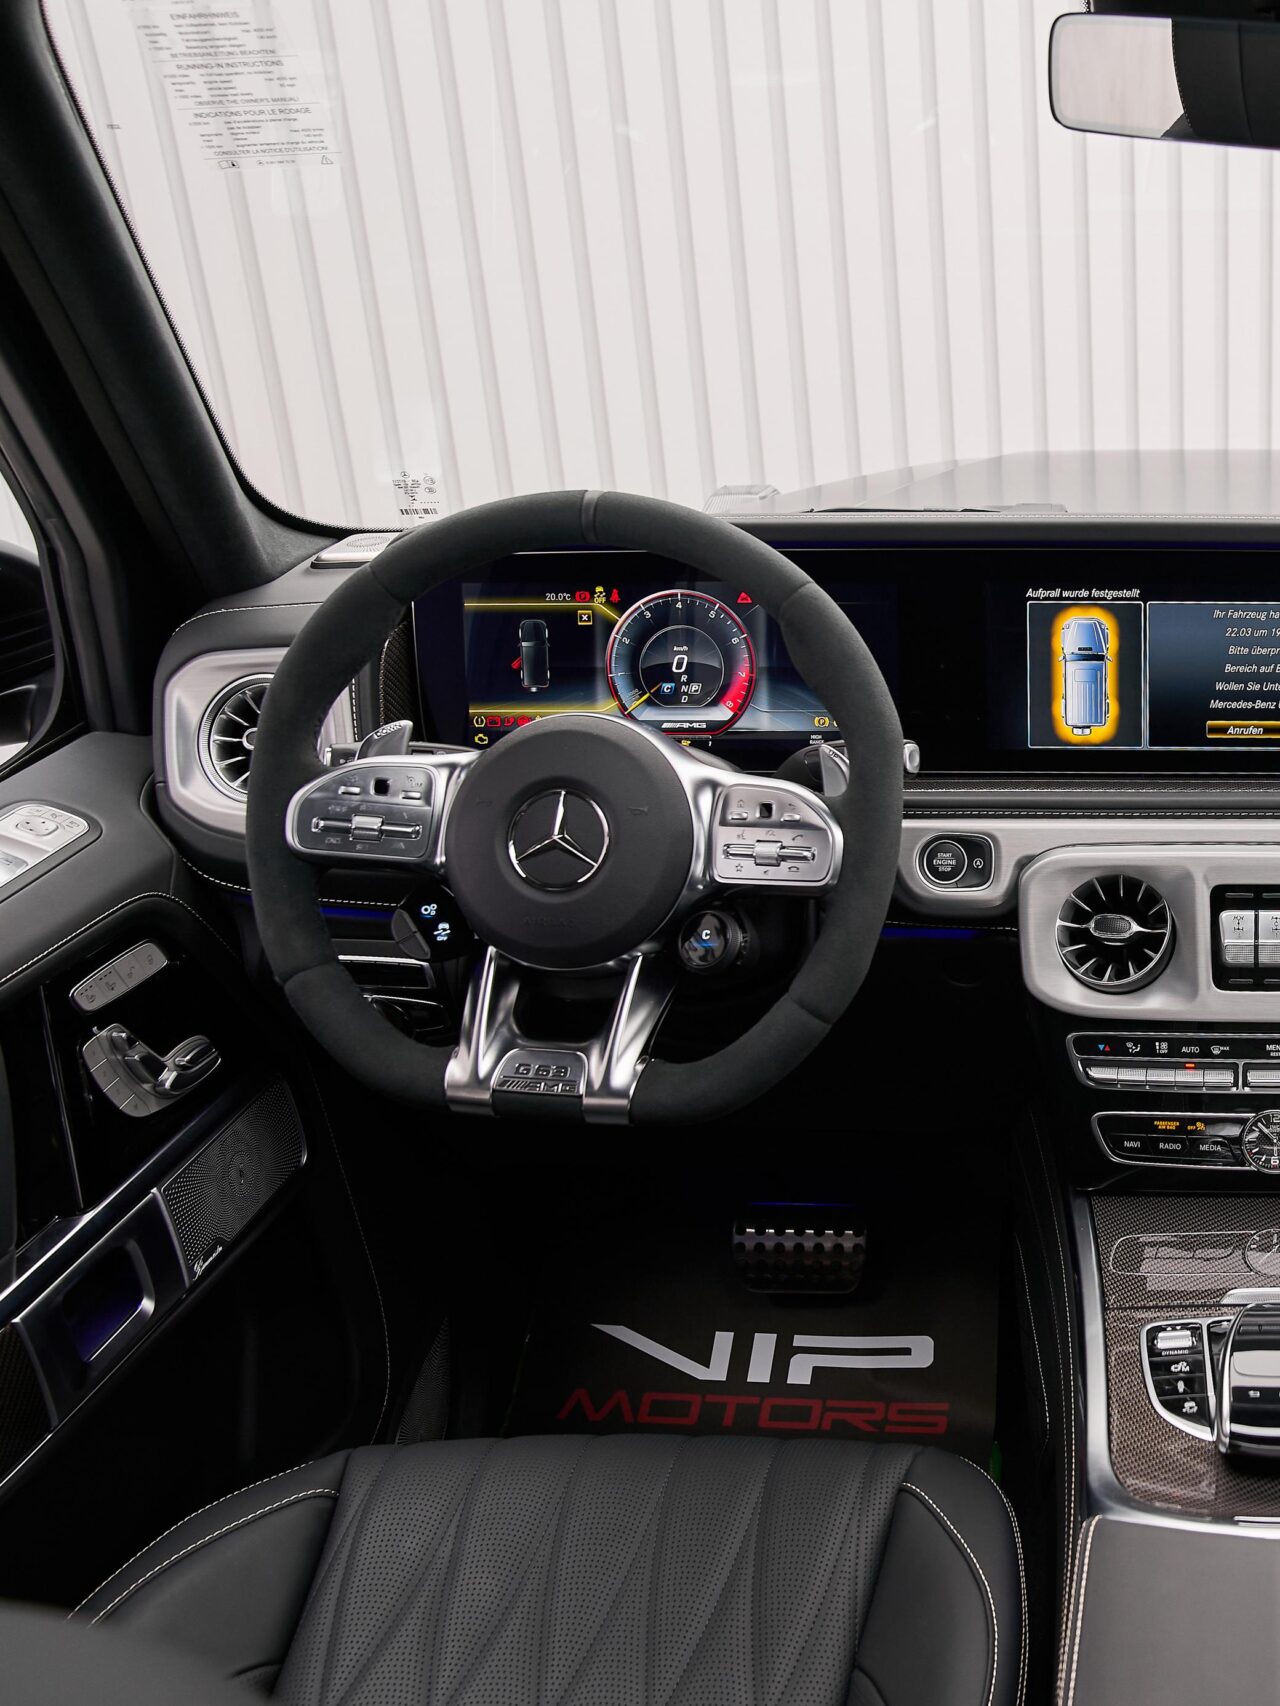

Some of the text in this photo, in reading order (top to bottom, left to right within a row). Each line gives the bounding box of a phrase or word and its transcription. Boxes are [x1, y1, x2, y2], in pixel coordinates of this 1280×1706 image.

[224, 60, 285, 69] INSTRUCTIONS
[193, 110, 243, 119] INDICATIONS
[244, 109, 266, 117] POUR
[279, 107, 312, 115] RODAGE
[1026, 588, 1140, 600] Aufprall wurde festgestellt
[643, 611, 652, 619] 3
[708, 611, 717, 619] 5
[1213, 609, 1226, 619] Ihr
[1227, 609, 1267, 620] Fahrzeug
[1225, 628, 1252, 637] 22.03
[1253, 629, 1268, 637] um
[622, 637, 630, 645] 2
[731, 637, 739, 645] 6
[1228, 645, 1249, 655] Bitte
[672, 655, 688, 673] 0
[1224, 663, 1258, 673] Bereich
[1259, 663, 1274, 673] auf
[1215, 681, 1245, 691] Wollen
[1246, 682, 1261, 691] Sie
[1209, 699, 1277, 709] Mercedes-Benz
[1226, 726, 1264, 735] Anrufen
[701, 930, 711, 940] C
[1181, 1046, 1200, 1054] AUTO
[1270, 1114, 1280, 1123] 12
[1124, 1140, 1141, 1148] NAVI
[1159, 1142, 1181, 1150] RADIO
[1271, 1156, 1279, 1165] 6
[591, 1323, 934, 1385] VIP
[557, 1388, 950, 1434] MOTORS
